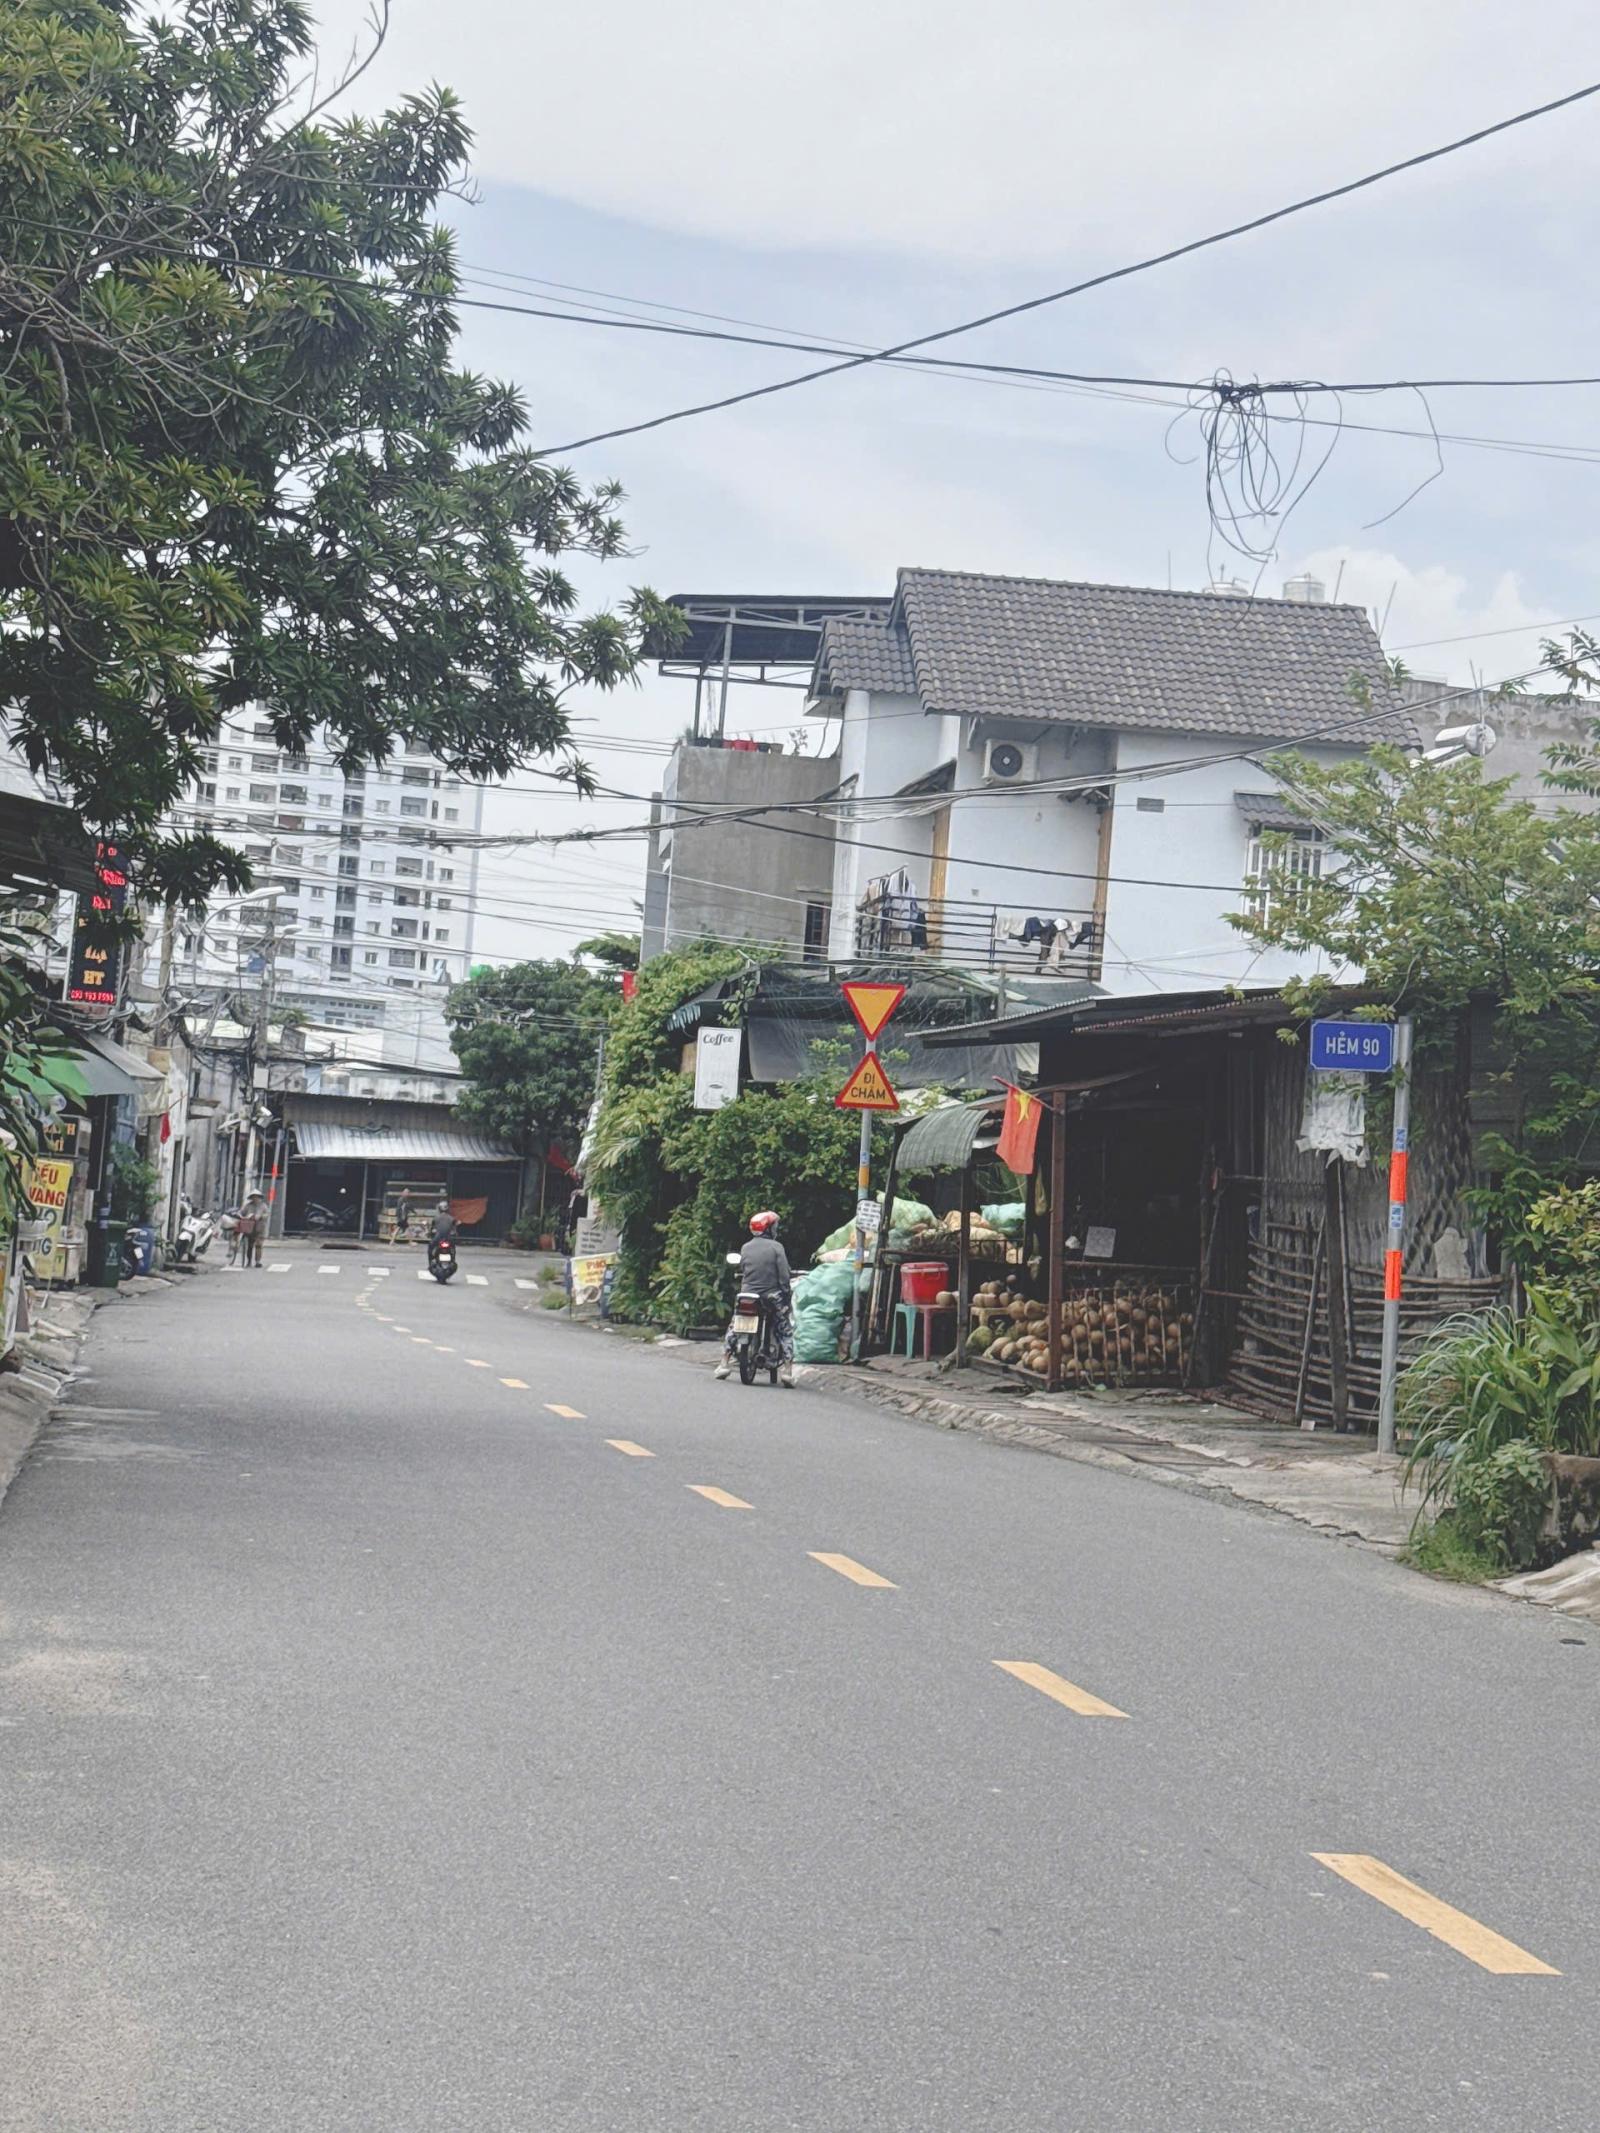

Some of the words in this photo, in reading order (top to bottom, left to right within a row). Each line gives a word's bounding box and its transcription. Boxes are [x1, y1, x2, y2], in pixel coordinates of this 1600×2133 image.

[702, 1033, 735, 1046] Coffee
[1326, 1030, 1359, 1055] HẺM
[1363, 1038, 1380, 1056] 90
[863, 1072, 876, 1085] ĐI
